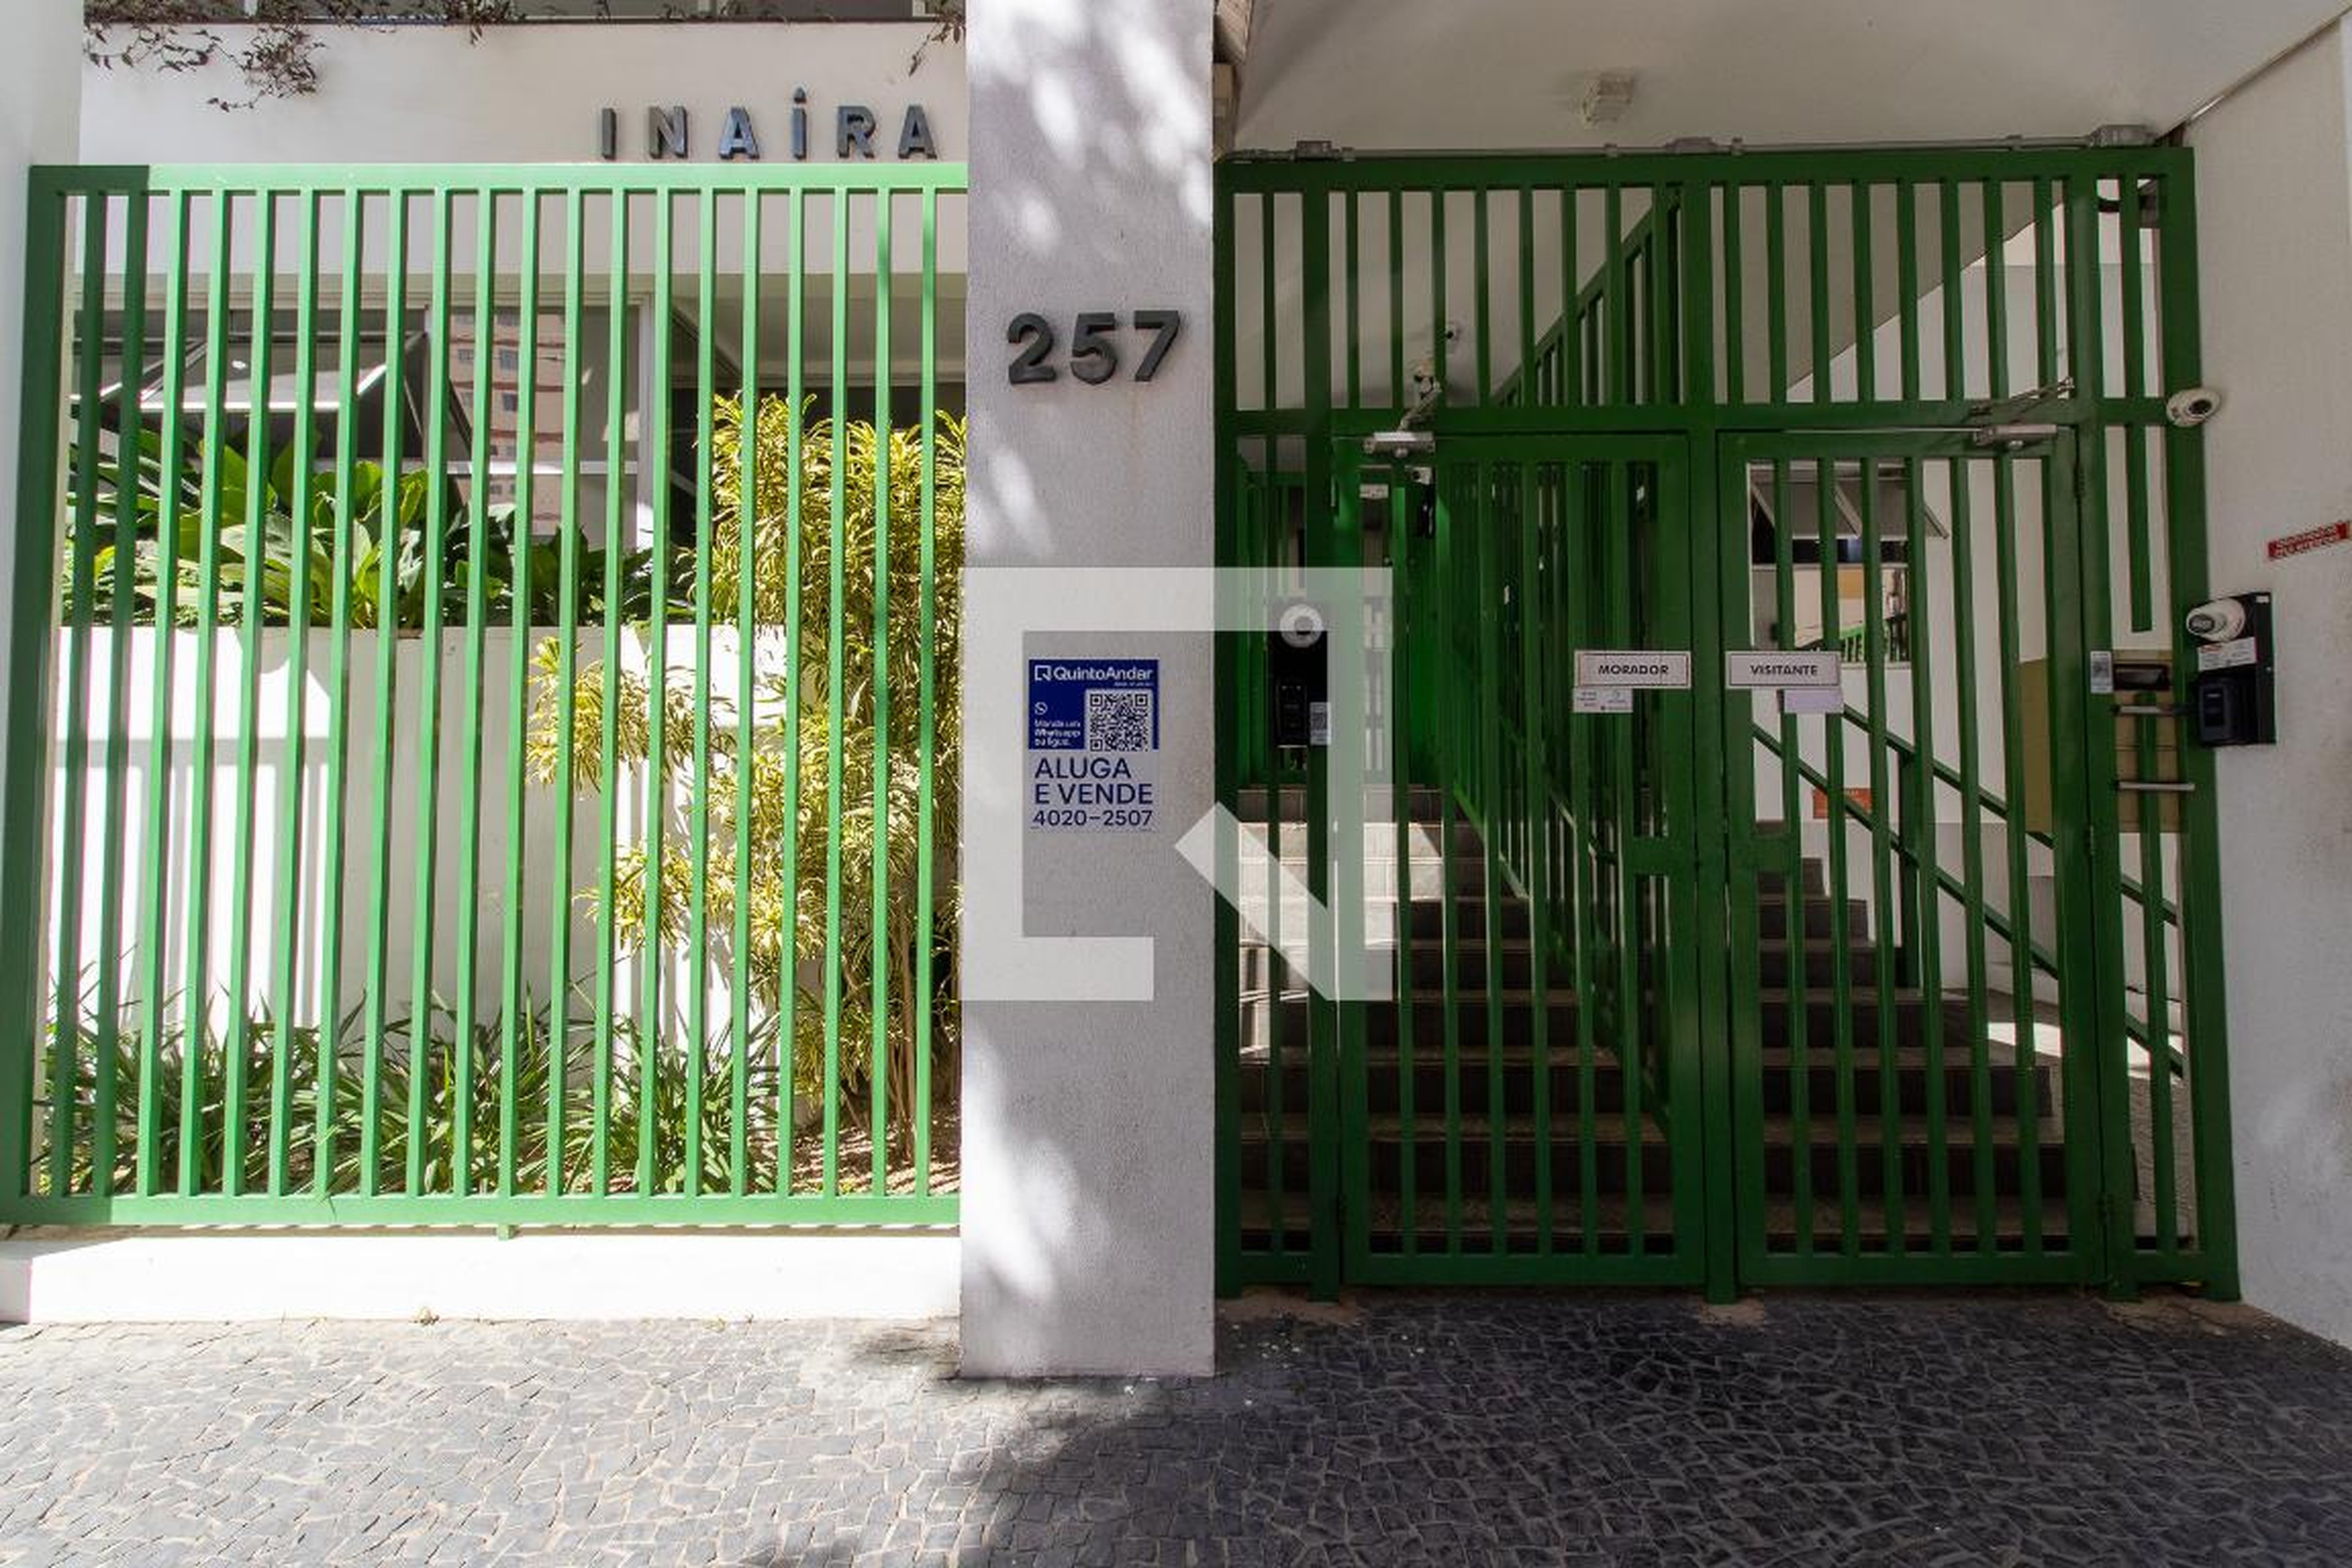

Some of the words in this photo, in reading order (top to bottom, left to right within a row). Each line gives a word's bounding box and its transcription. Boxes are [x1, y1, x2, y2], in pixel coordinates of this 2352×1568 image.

[1008, 309, 1180, 385] 257
[1053, 666, 1154, 681] QuintoAndar
[1597, 664, 1670, 676] MORADOR
[1750, 664, 1819, 676] VISITANTE
[1035, 758, 1132, 778] ALUGA
[1035, 783, 1050, 804] E
[1058, 783, 1153, 804] VENDE
[1033, 810, 1153, 826] 4020-2507
